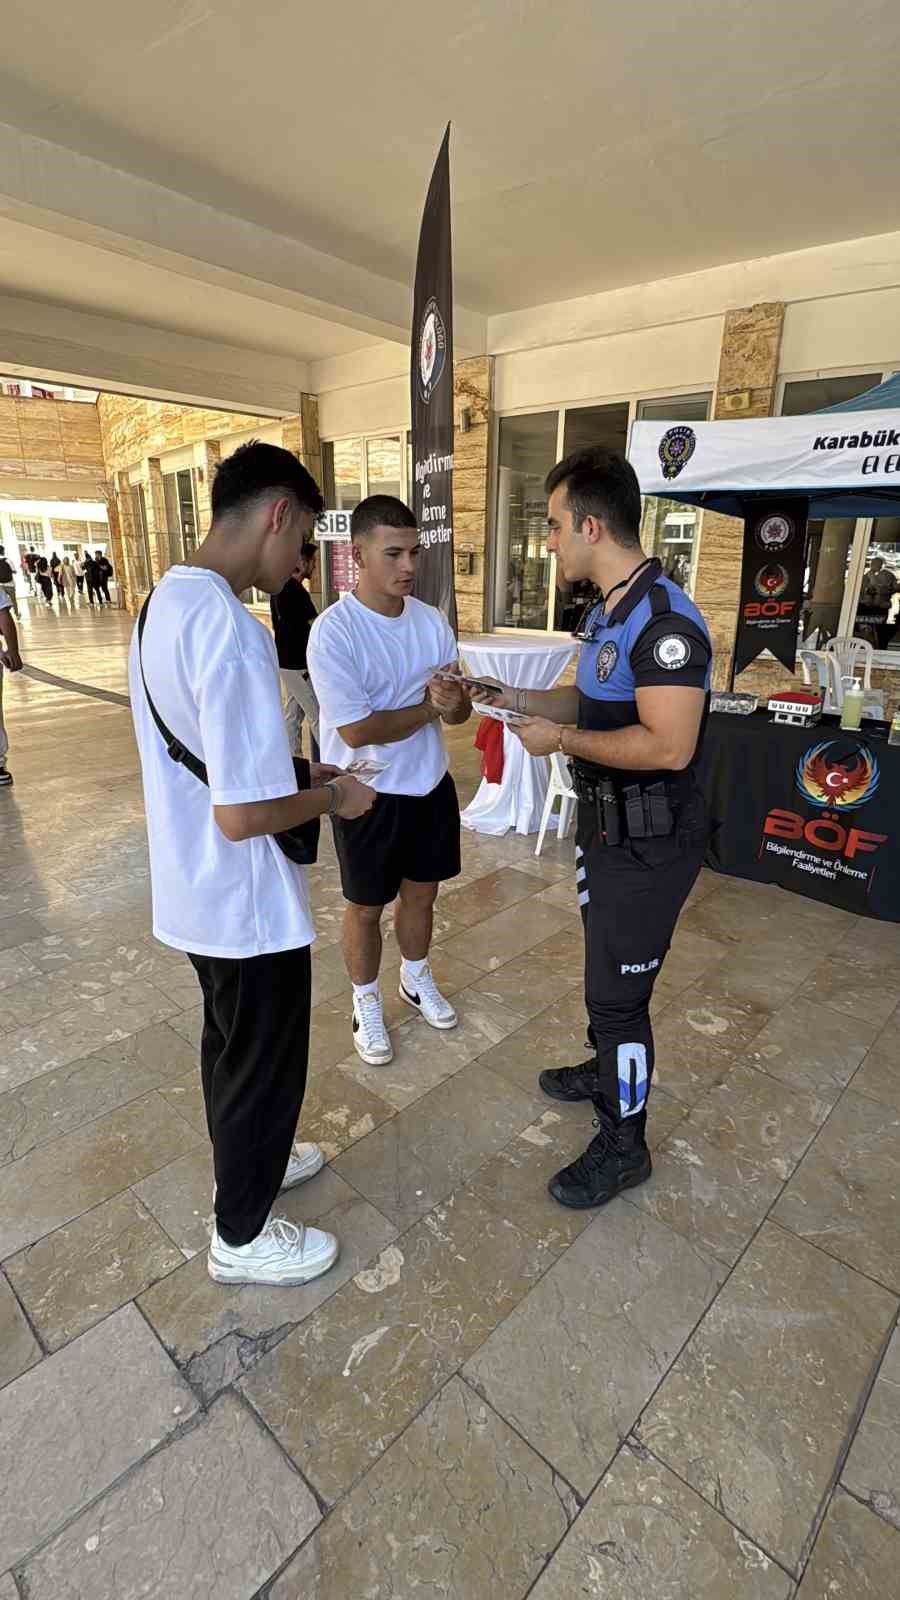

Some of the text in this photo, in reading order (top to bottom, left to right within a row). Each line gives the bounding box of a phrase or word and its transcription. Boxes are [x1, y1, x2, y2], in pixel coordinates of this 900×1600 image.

[813, 429, 900, 450] Karabük
[317, 511, 352, 533] SiB
[764, 808, 888, 859] BÖF
[766, 841, 868, 880] Bilgilendirme ve Önleme
[792, 859, 837, 880] Faaliyetleri
